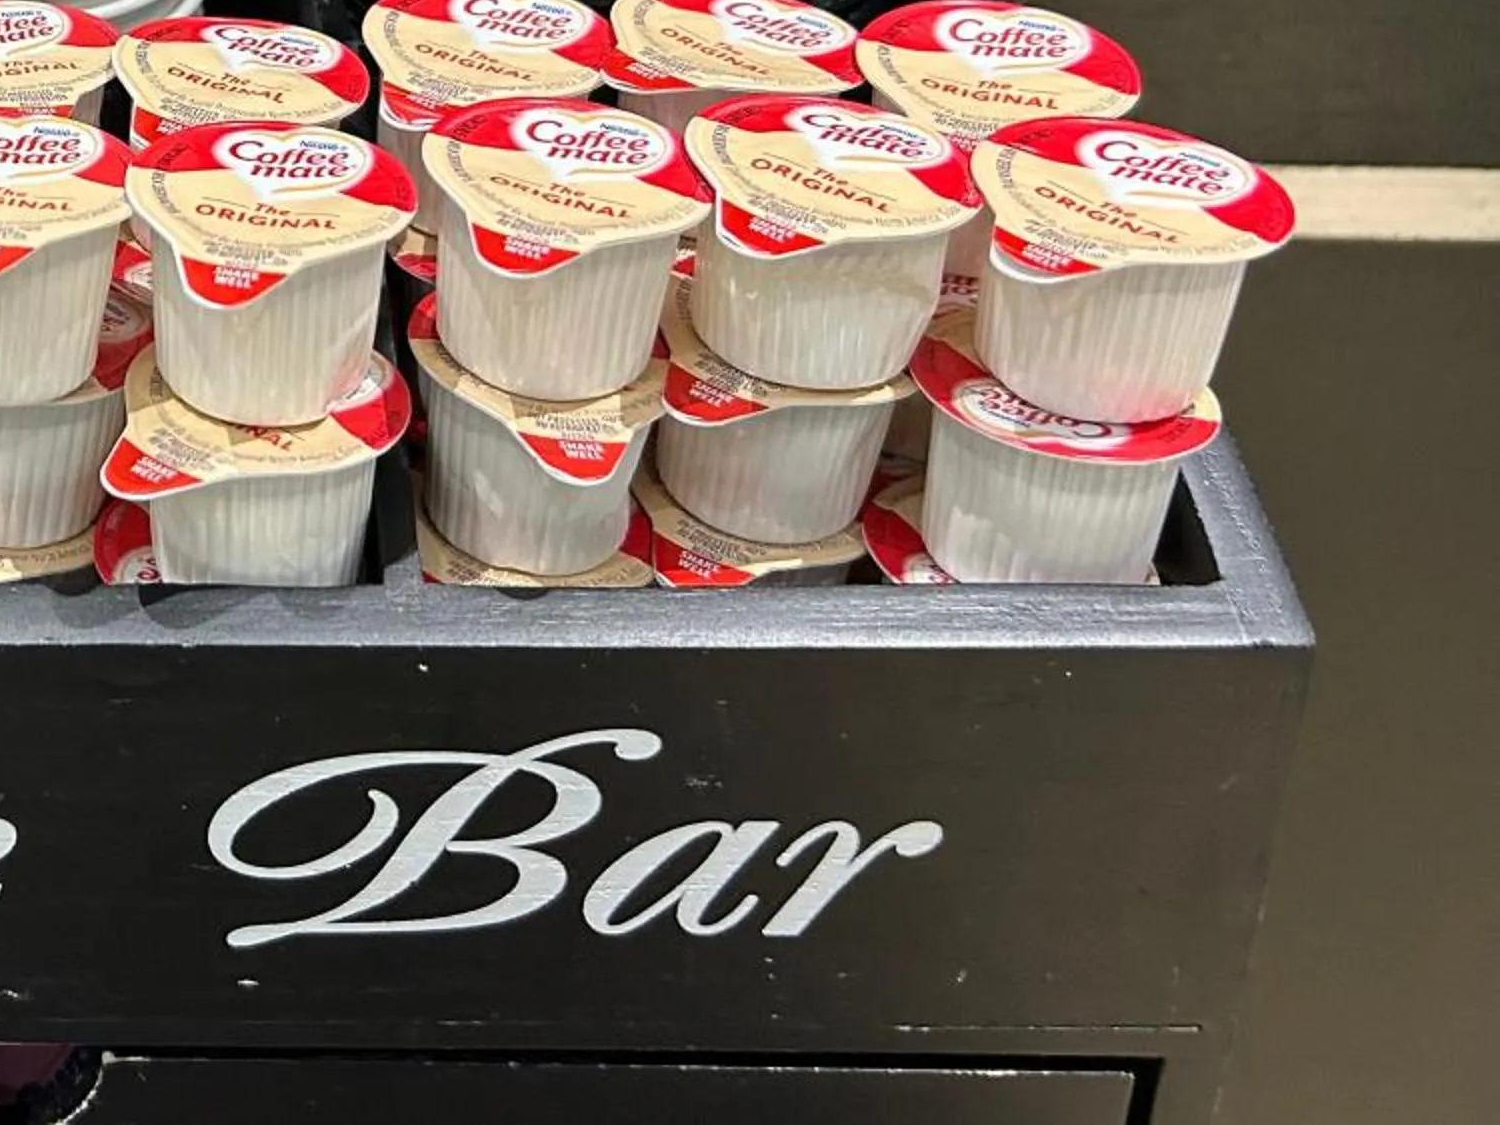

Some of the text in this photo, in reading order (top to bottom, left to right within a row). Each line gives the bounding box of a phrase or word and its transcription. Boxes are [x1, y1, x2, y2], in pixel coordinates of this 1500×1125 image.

[475, 19, 567, 39] mate
[725, 2, 833, 38] Coffee
[949, 18, 1068, 46] Coffee
[214, 27, 320, 56] Coffee
[731, 21, 822, 48] mate
[227, 43, 315, 67] mate
[415, 43, 533, 82] ORIGINAL
[468, 50, 499, 63] The
[660, 27, 771, 76] ORIGINAL
[714, 42, 744, 56] The
[970, 43, 1069, 59] mate
[3, 60, 33, 68] The
[167, 66, 285, 104] ORIGINAL
[219, 72, 251, 86] The
[977, 79, 1013, 91] The
[920, 77, 1060, 110] ORIGINAL
[527, 120, 650, 151] Coffee
[802, 114, 927, 148] Coffee
[819, 129, 924, 158] mate
[229, 140, 350, 166] Coffee
[547, 147, 648, 165] mate
[1095, 140, 1231, 180] Coffee
[250, 165, 349, 179] mate
[749, 158, 890, 213] ORIGINAL
[812, 167, 849, 186] The
[1108, 166, 1223, 195] mate
[490, 175, 632, 218] ORIGINAL
[549, 182, 587, 197] The
[195, 204, 337, 230] ORIGINAL
[254, 202, 292, 216] The
[1034, 186, 1182, 244] ORIGINAL
[1099, 201, 1138, 218] The
[207, 729, 944, 948] Bar
